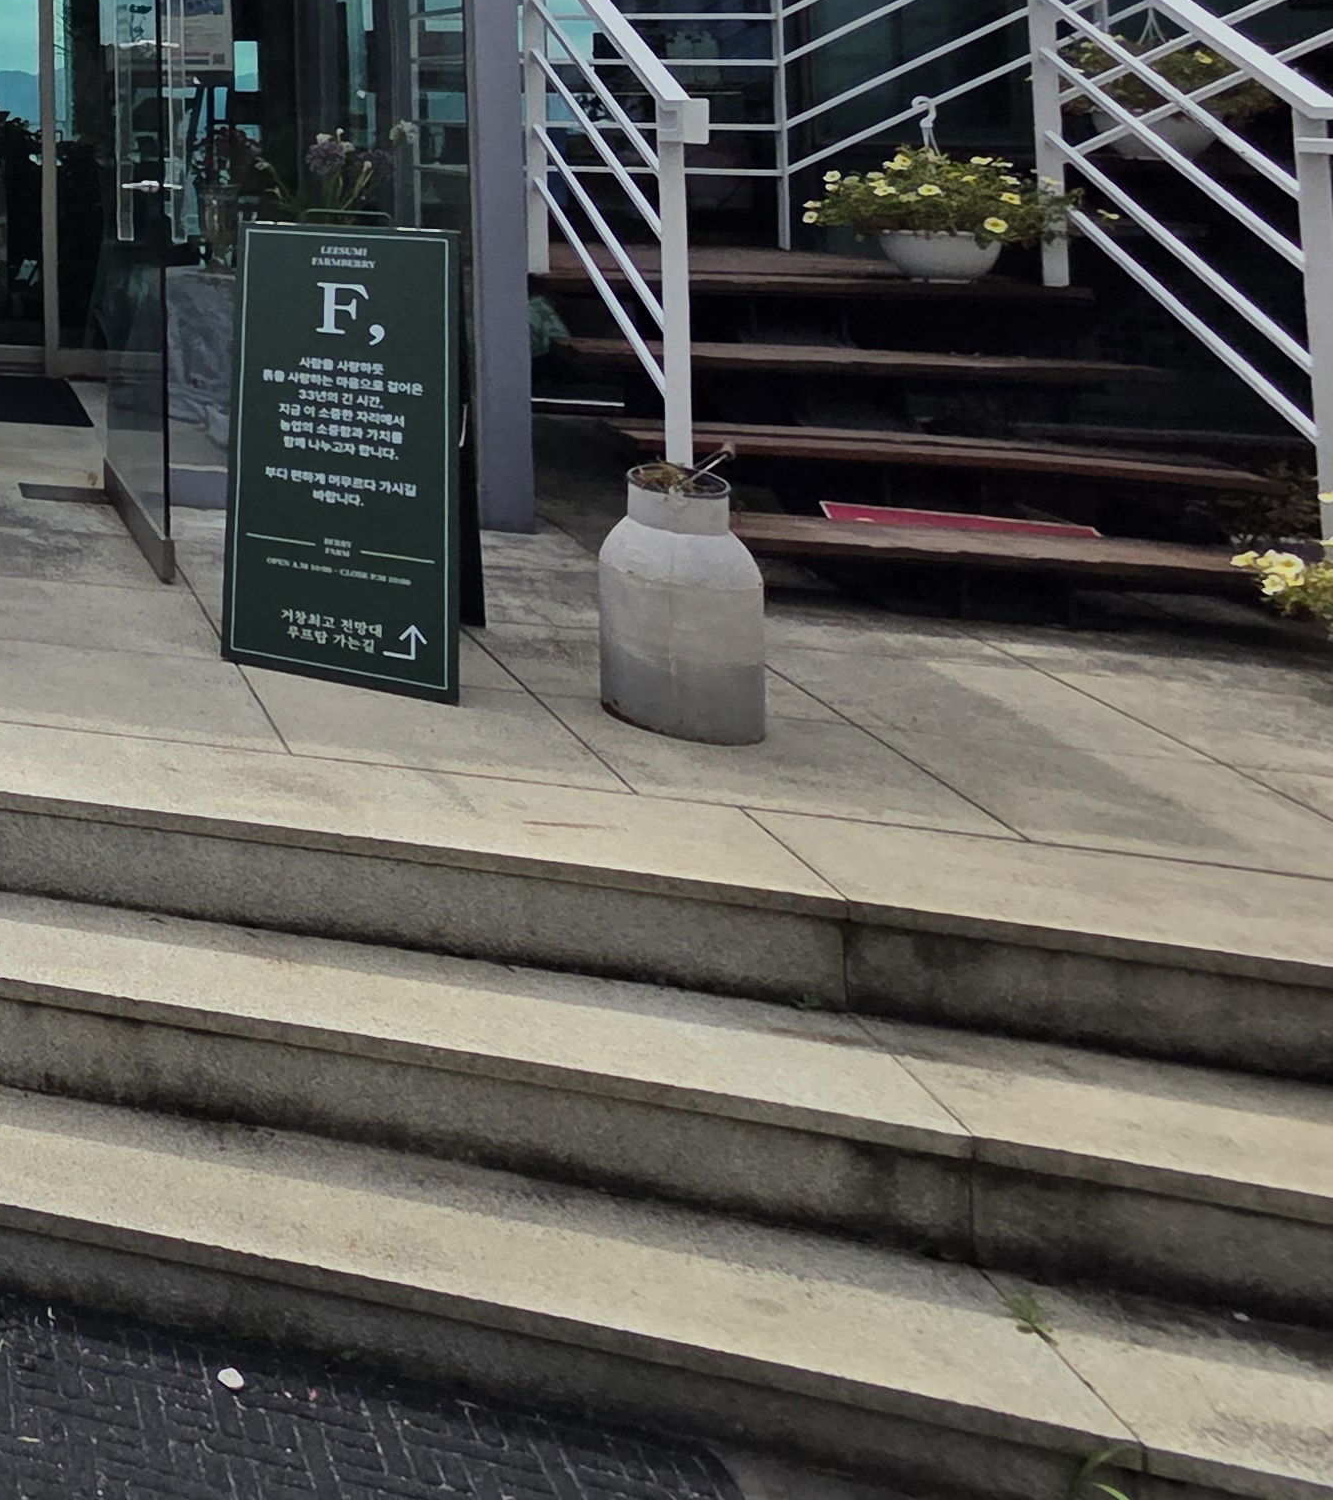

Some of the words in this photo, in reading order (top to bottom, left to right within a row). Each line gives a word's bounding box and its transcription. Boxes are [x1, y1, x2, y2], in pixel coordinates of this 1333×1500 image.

[320, 246, 368, 256] LEESUMI
[311, 257, 376, 269] FARMBERRY
[316, 282, 385, 346] F,
[299, 357, 333, 370] 사람을
[337, 360, 384, 376] 사랑하듯
[263, 369, 285, 382] 흙을
[288, 372, 333, 386] 사랑하는
[336, 377, 384, 392] 마음으로
[299, 389, 338, 404] 33년의
[342, 393, 353, 405] 긴
[357, 396, 384, 409] 시간.
[279, 403, 300, 416] 지금
[303, 406, 315, 417] 이
[318, 408, 353, 421] 소중한
[356, 411, 405, 428] 자리에서
[280, 419, 313, 433] 농업의
[317, 423, 364, 439] 소중함과
[367, 429, 403, 445] 가치를
[283, 436, 306, 449] 함께
[308, 439, 356, 455] 나누고자
[359, 445, 399, 461] 합니다.
[265, 466, 288, 480] 부디
[291, 469, 326, 485] 편하게
[328, 474, 376, 491] 머무르다
[379, 481, 417, 497] 가시길
[312, 489, 365, 506] 바랍니다.
[324, 537, 352, 548] BERRY
[325, 547, 351, 557] FARM
[266, 557, 290, 567] OPEN
[339, 568, 369, 580] CLOSE
[281, 609, 335, 629] 거창최고
[340, 619, 383, 638] 전망대
[287, 625, 328, 644] 루프탑
[333, 634, 375, 654] 가는길
